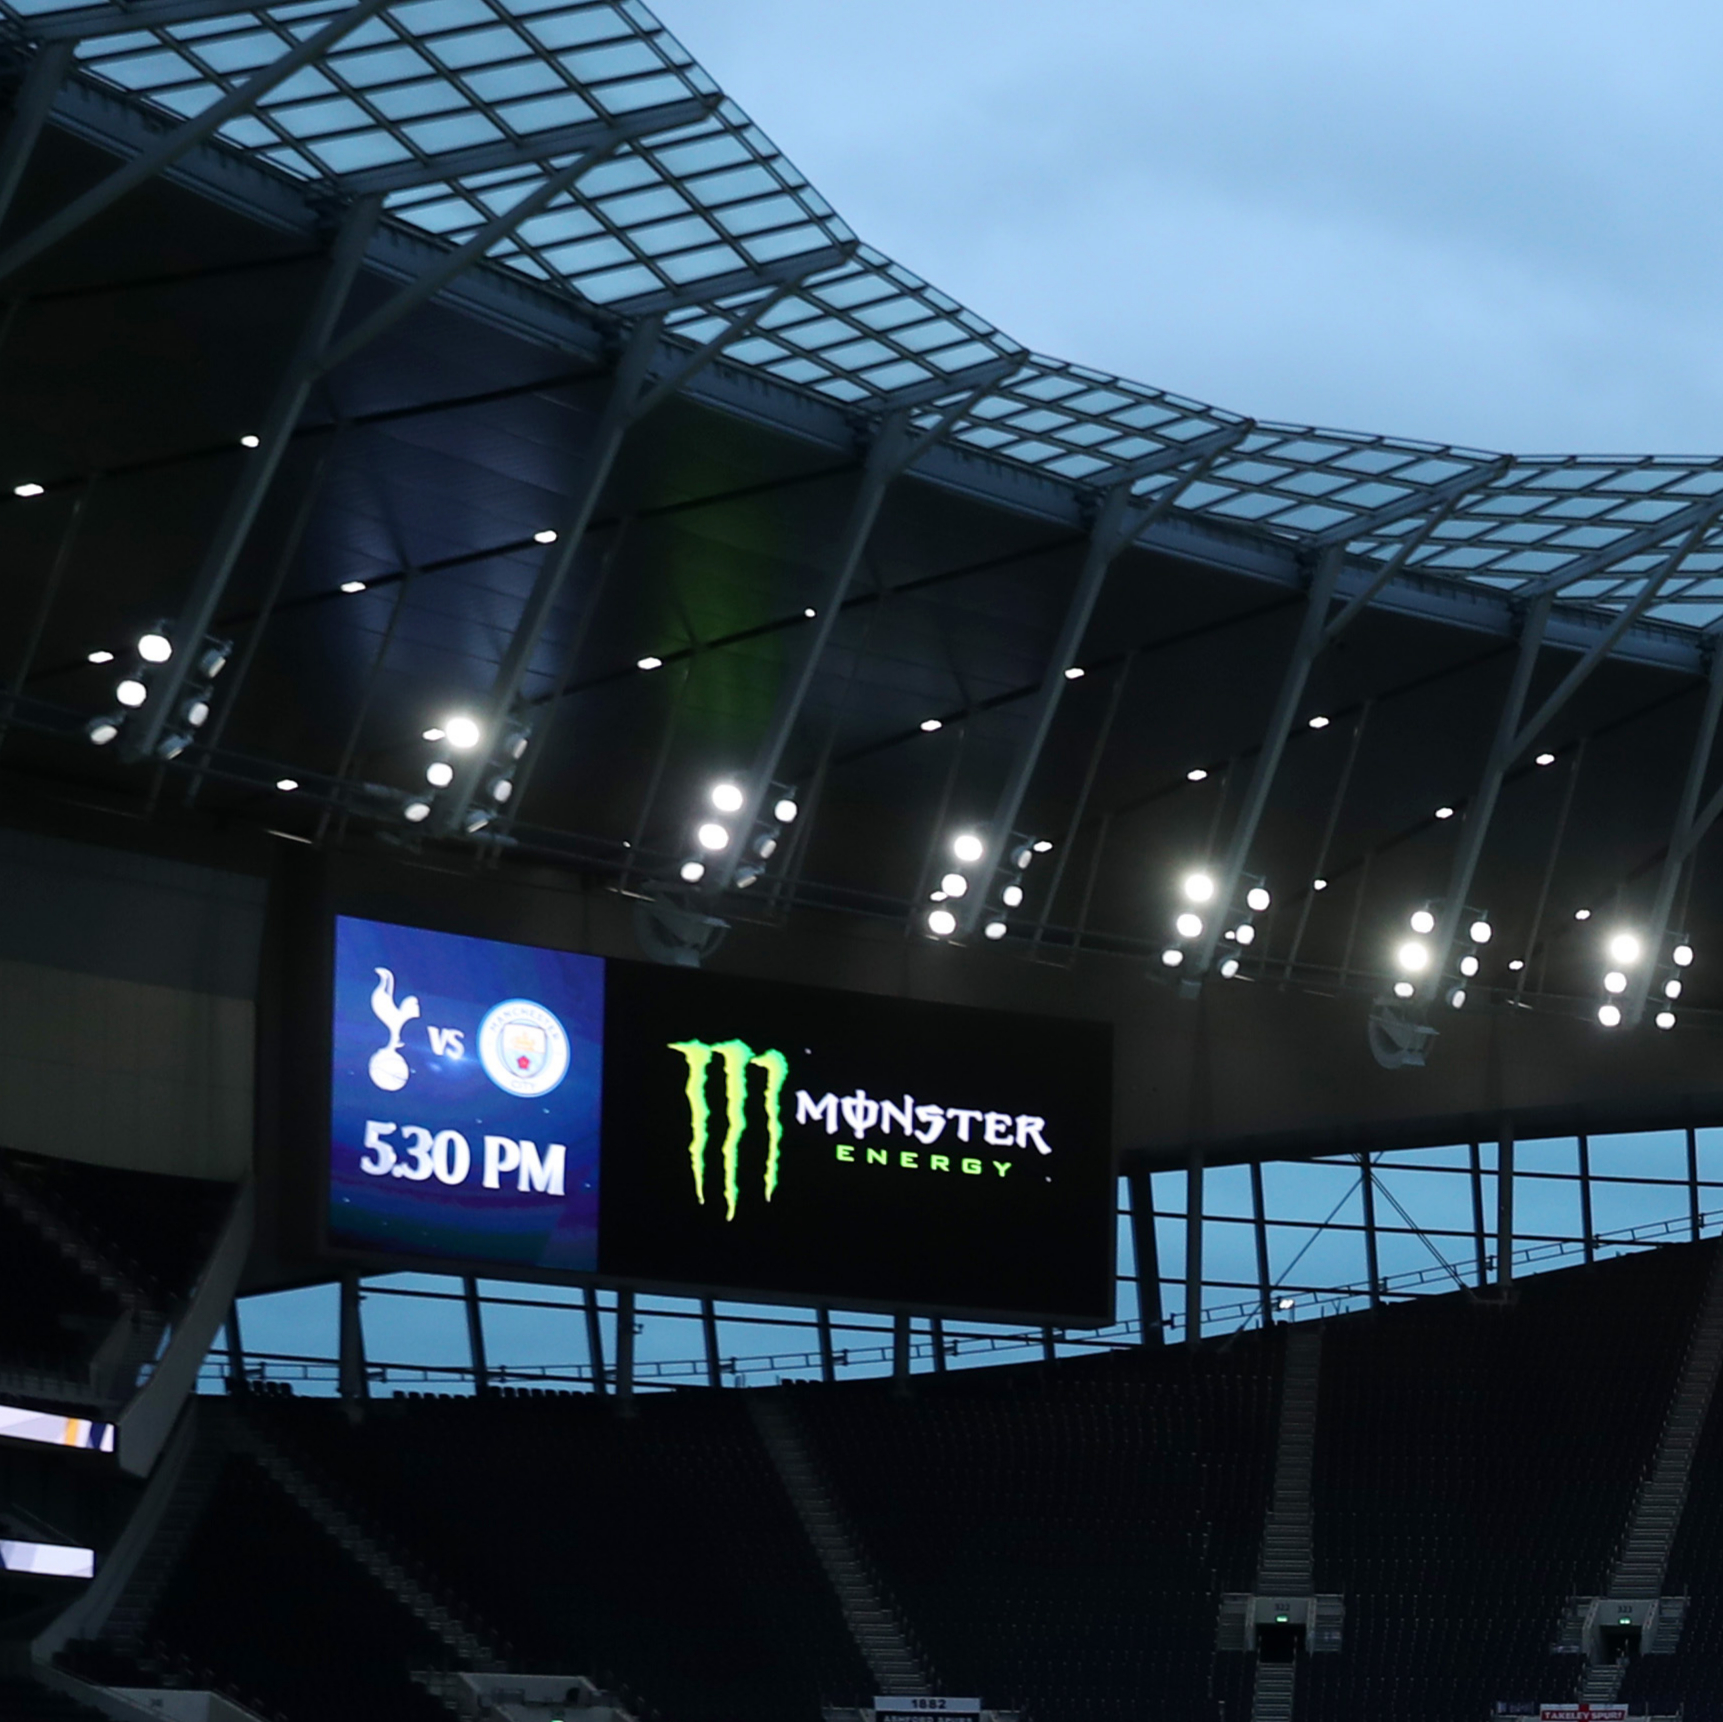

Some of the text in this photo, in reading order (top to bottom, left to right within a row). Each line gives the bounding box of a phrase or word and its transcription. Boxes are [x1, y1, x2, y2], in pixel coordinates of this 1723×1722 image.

[490, 1006, 561, 1041] MANCHESTER
[428, 1026, 464, 1059] VS
[796, 1090, 1052, 1155] MONSTER
[484, 1135, 567, 1196] PM
[836, 1144, 1013, 1178] ENERGY
[911, 1699, 947, 1710] 1882
